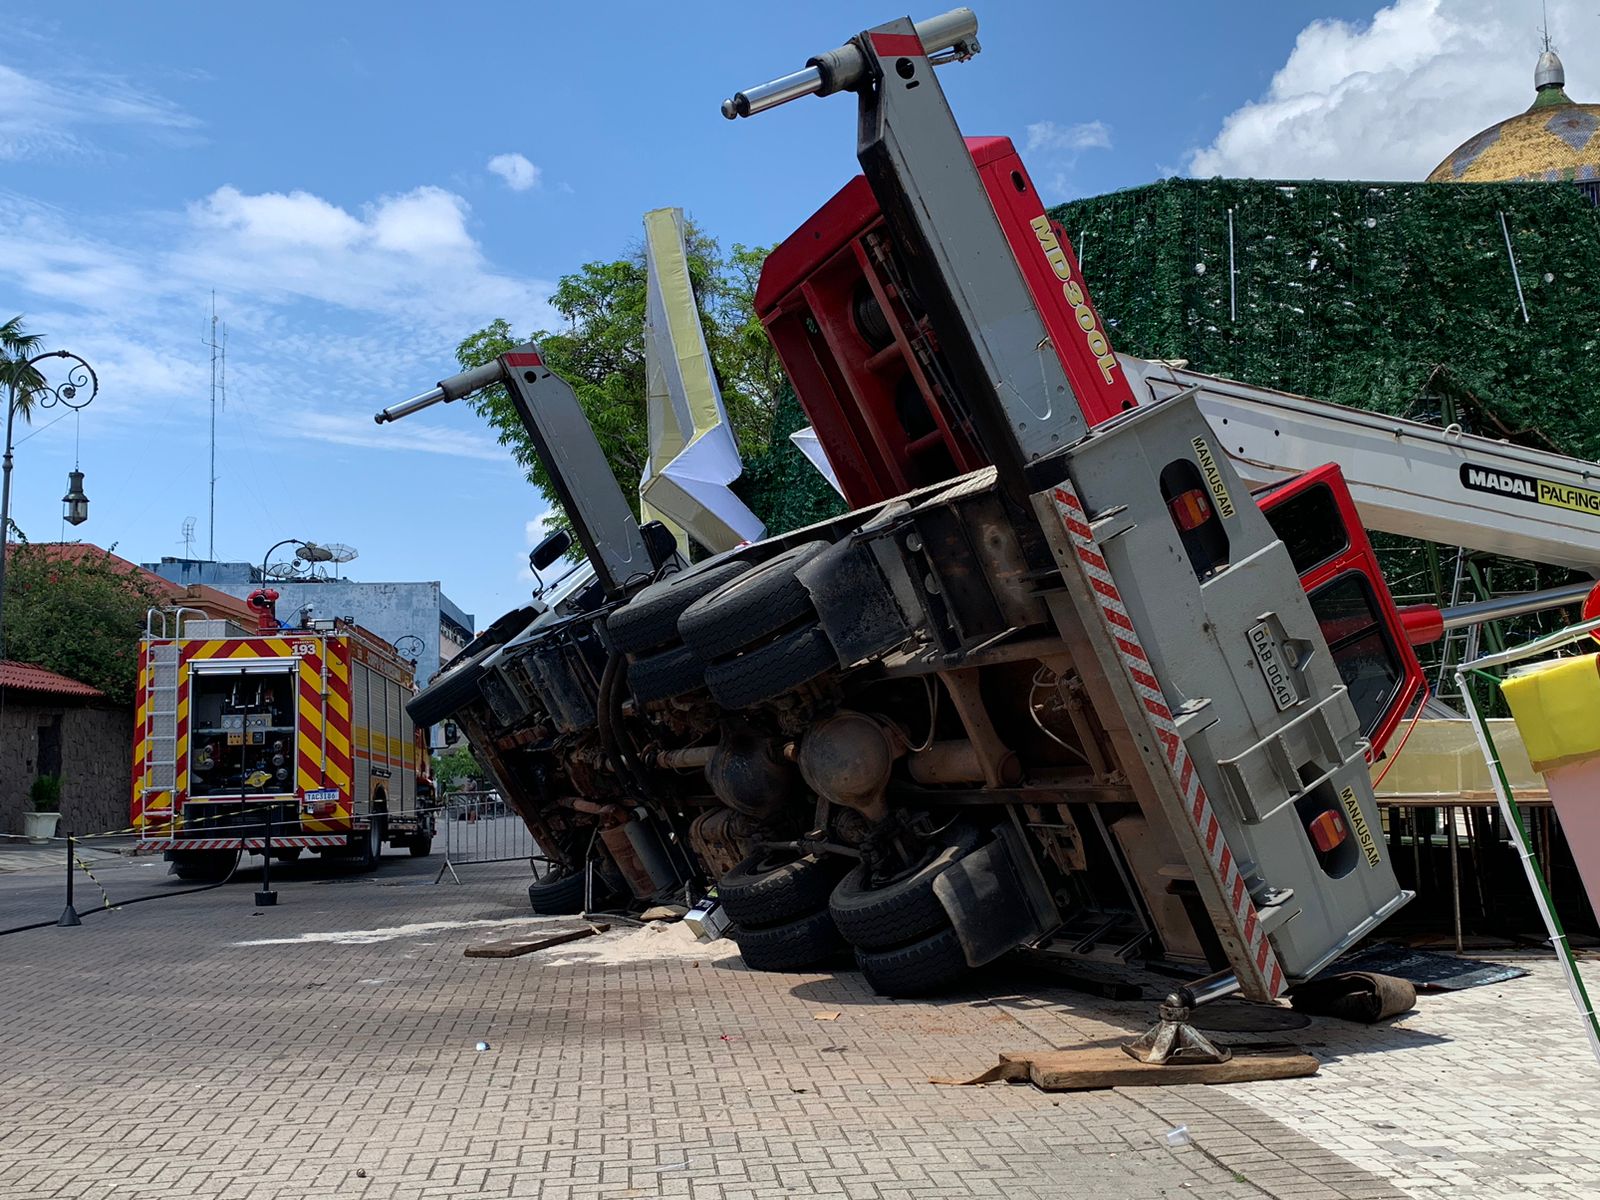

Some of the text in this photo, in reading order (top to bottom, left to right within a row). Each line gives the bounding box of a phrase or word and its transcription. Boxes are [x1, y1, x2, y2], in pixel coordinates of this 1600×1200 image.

[1030, 214, 1117, 385] MD300L
[1191, 436, 1233, 518] MANAUS/AM
[1468, 469, 1600, 511] MADAL PALFING
[292, 644, 316, 656] 193
[1341, 787, 1378, 868] MANAUS/AM
